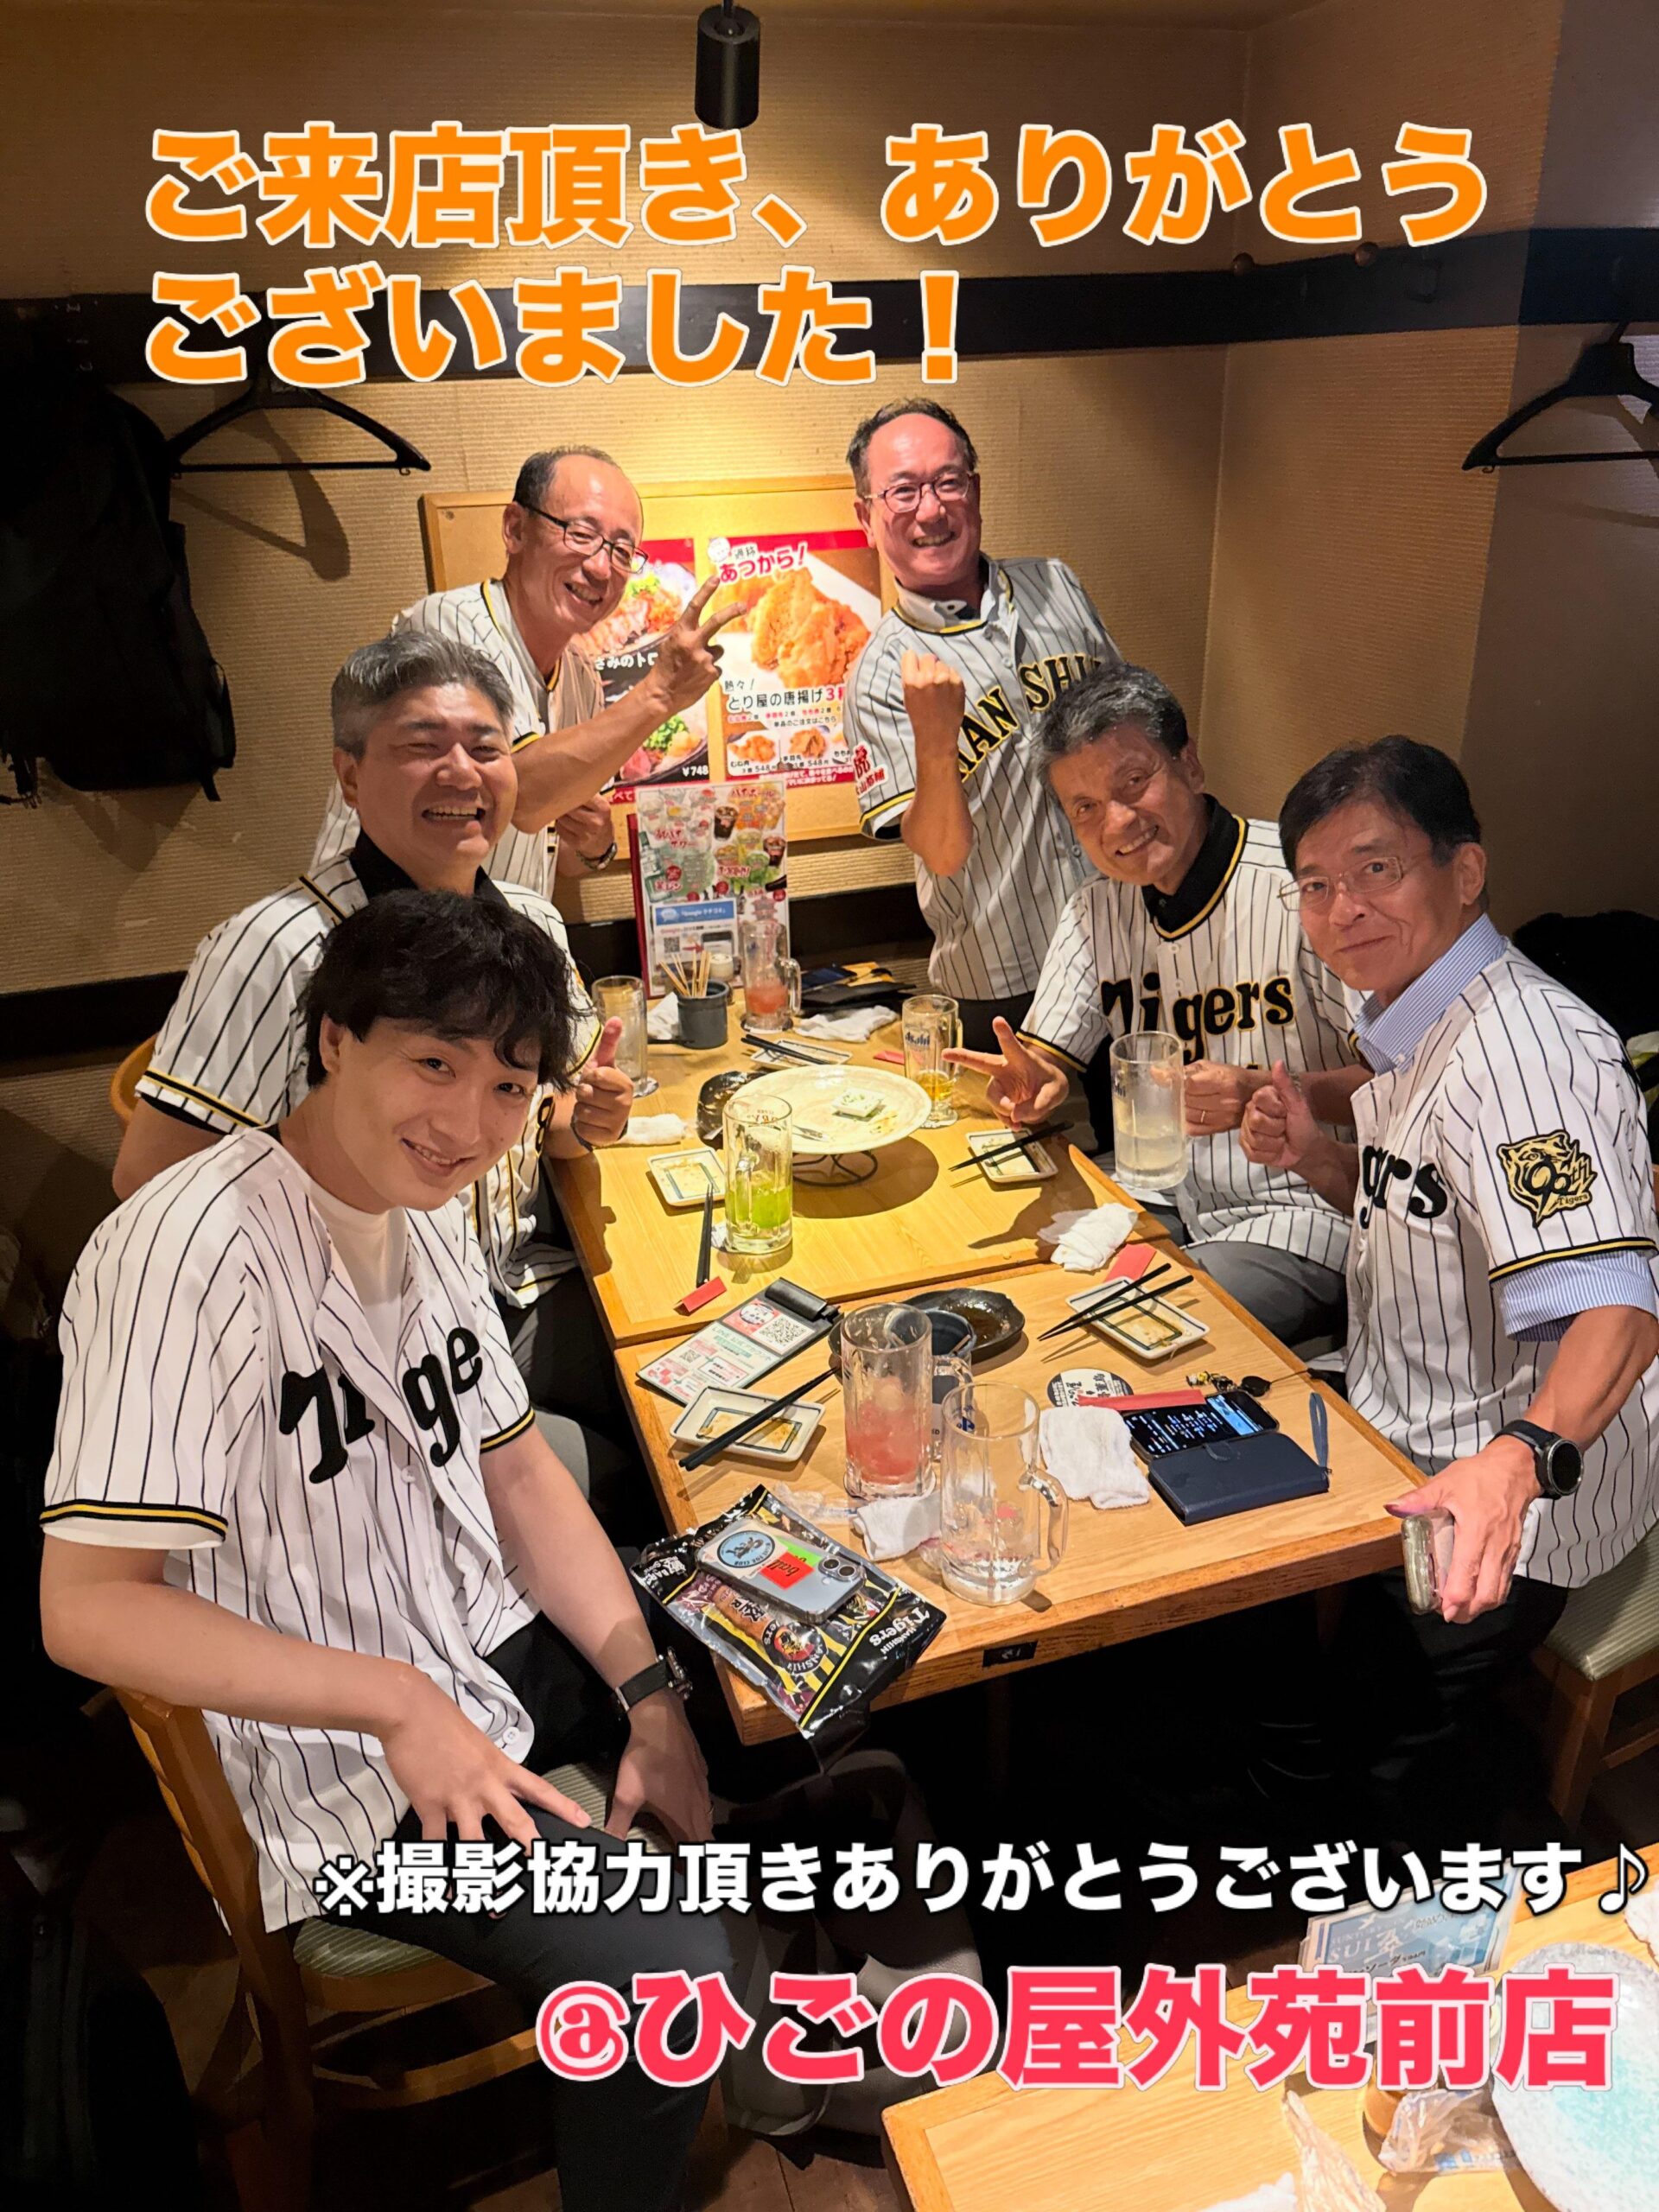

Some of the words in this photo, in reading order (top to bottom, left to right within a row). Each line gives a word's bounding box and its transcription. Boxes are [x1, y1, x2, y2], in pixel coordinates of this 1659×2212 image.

[1100, 972, 1295, 1065] Tigers
[1558, 1193, 1588, 1206] Tigers
[868, 1606, 931, 1647] Tigers
